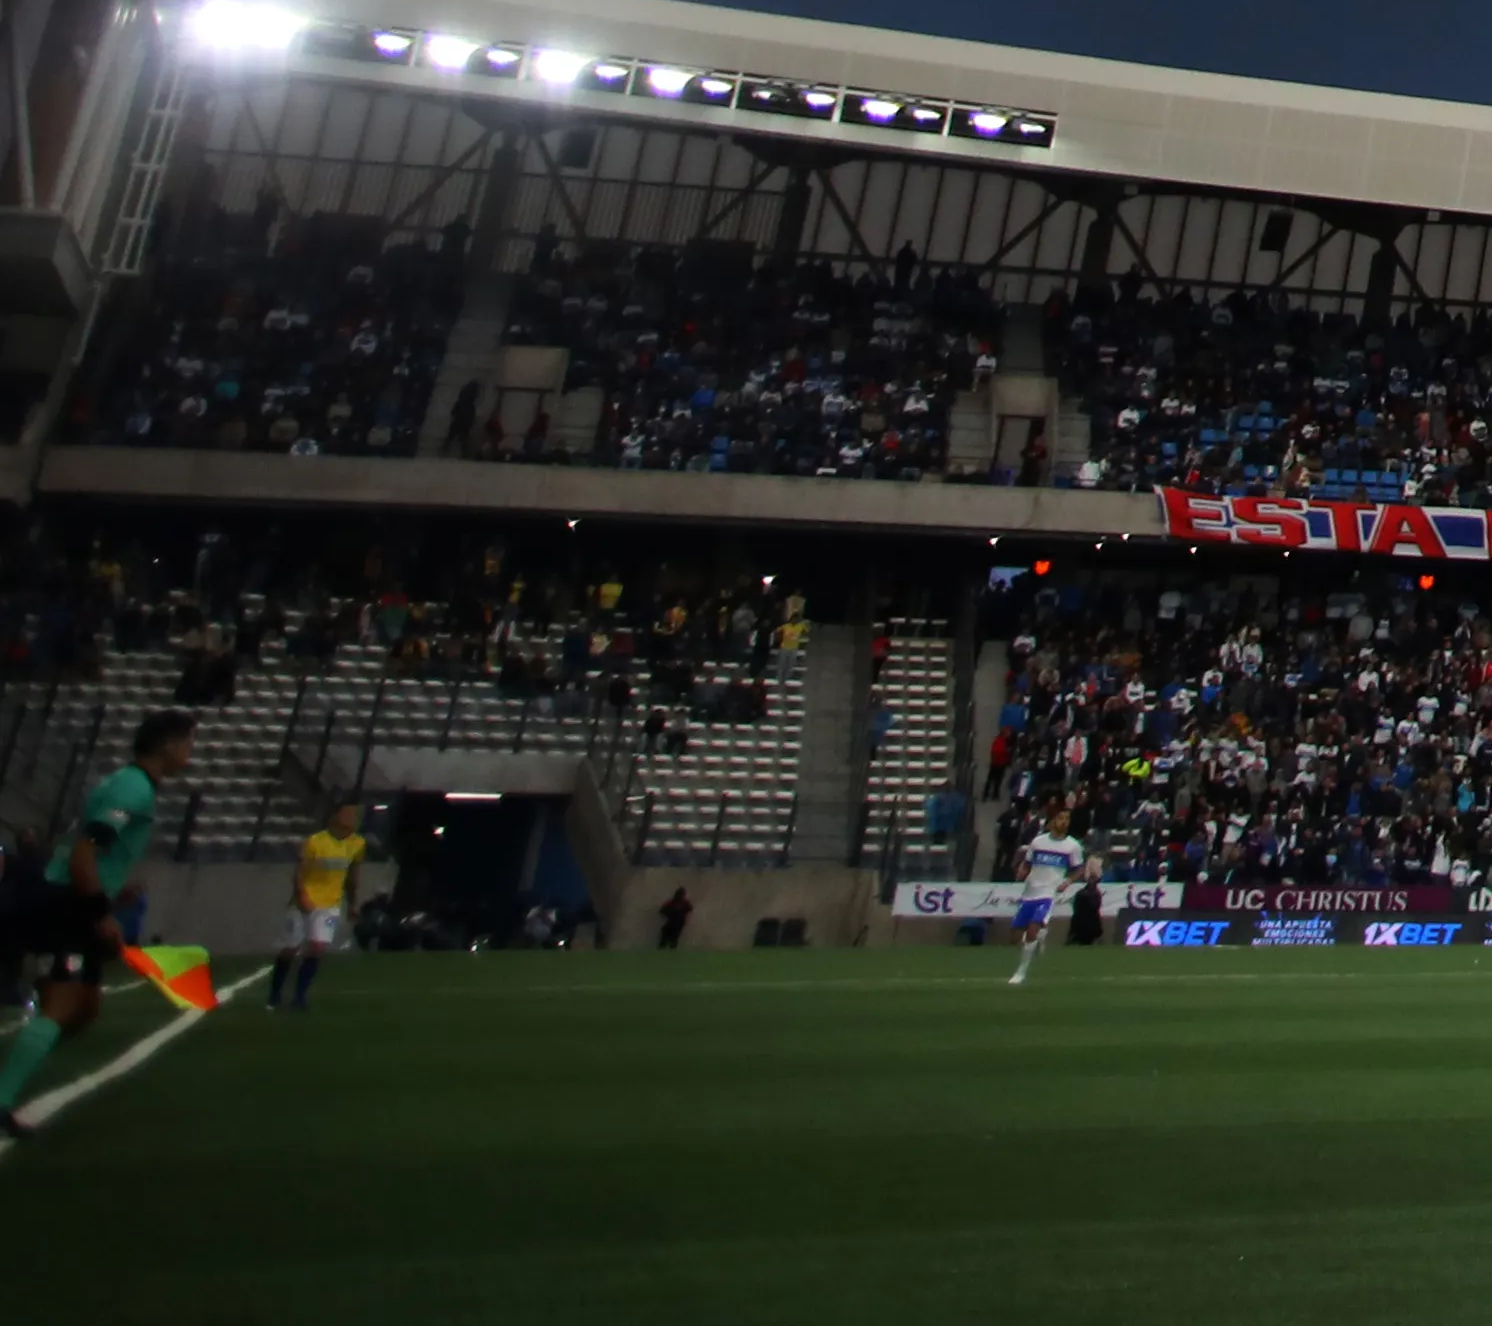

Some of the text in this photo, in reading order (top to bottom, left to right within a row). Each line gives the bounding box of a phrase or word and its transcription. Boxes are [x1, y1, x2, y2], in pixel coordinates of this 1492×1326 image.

[1160, 486, 1448, 559] ESTA
[914, 884, 955, 914] ist
[1126, 883, 1166, 909] ist
[1225, 889, 1408, 911] UC CHRISTUS
[1125, 921, 1230, 946] 1XBET
[1365, 921, 1463, 946] 1XBET
